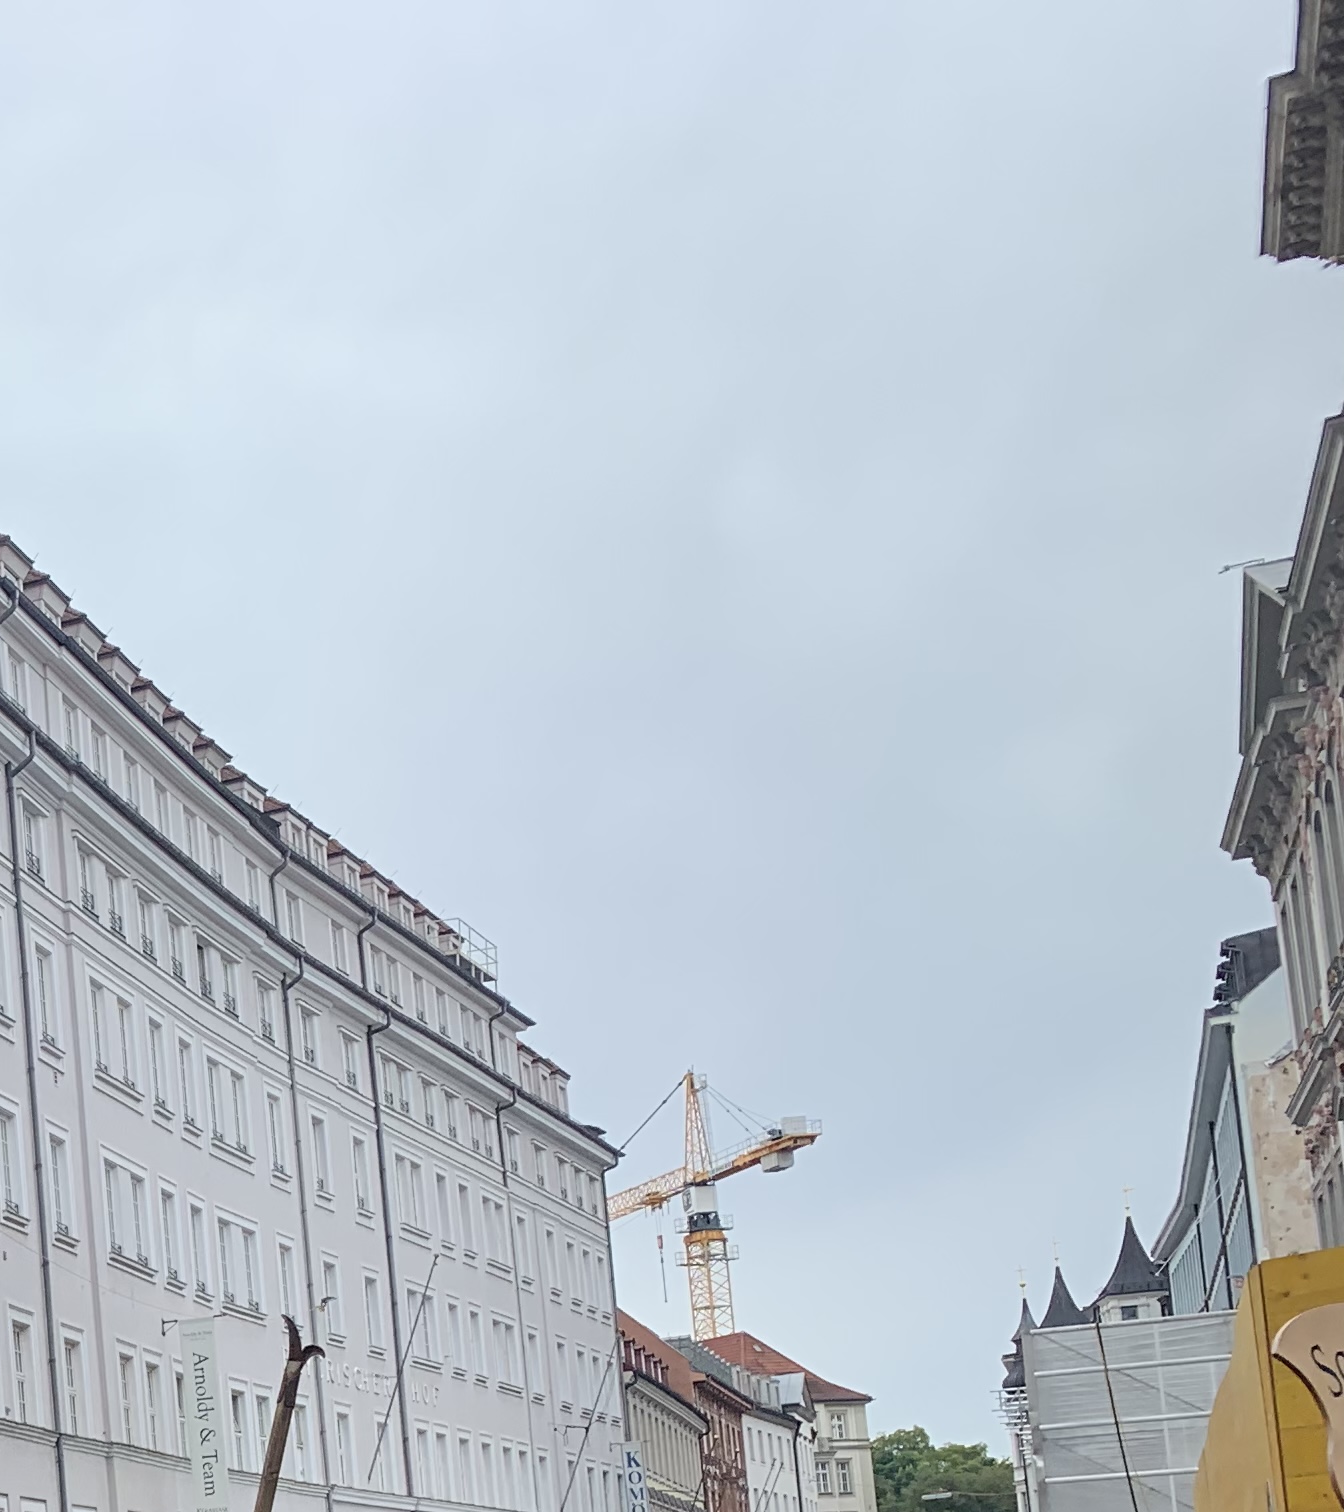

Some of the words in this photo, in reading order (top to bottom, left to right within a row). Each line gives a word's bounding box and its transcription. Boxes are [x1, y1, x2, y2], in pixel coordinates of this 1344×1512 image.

[192, 1351, 214, 1422] Arnoldy
[199, 1428, 217, 1446] &
[201, 1449, 219, 1497] Team
